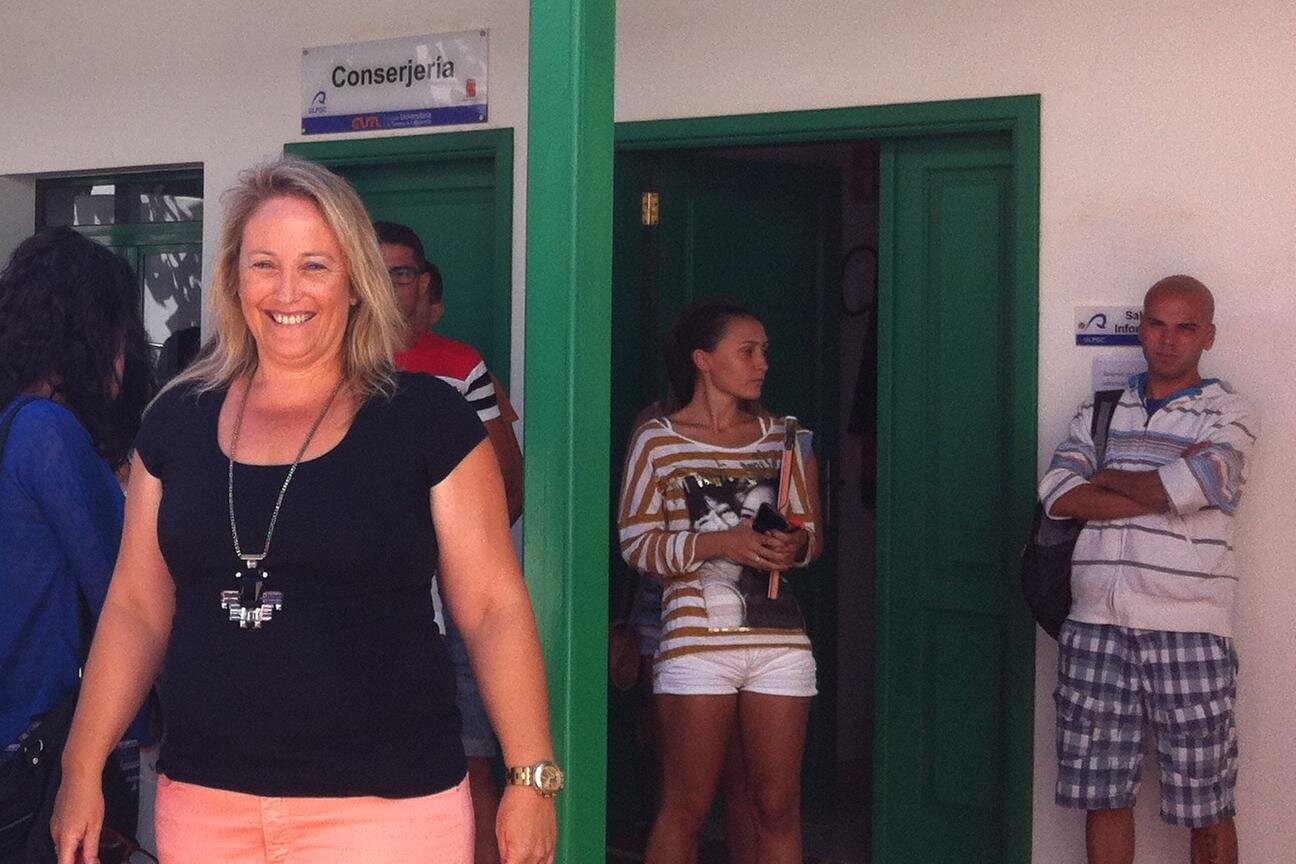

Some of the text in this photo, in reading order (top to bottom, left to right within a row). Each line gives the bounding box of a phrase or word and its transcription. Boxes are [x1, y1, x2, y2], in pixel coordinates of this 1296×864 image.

[332, 56, 454, 88] Conserjería
[1125, 310, 1143, 321] Sal
[1114, 324, 1139, 333] Infor
